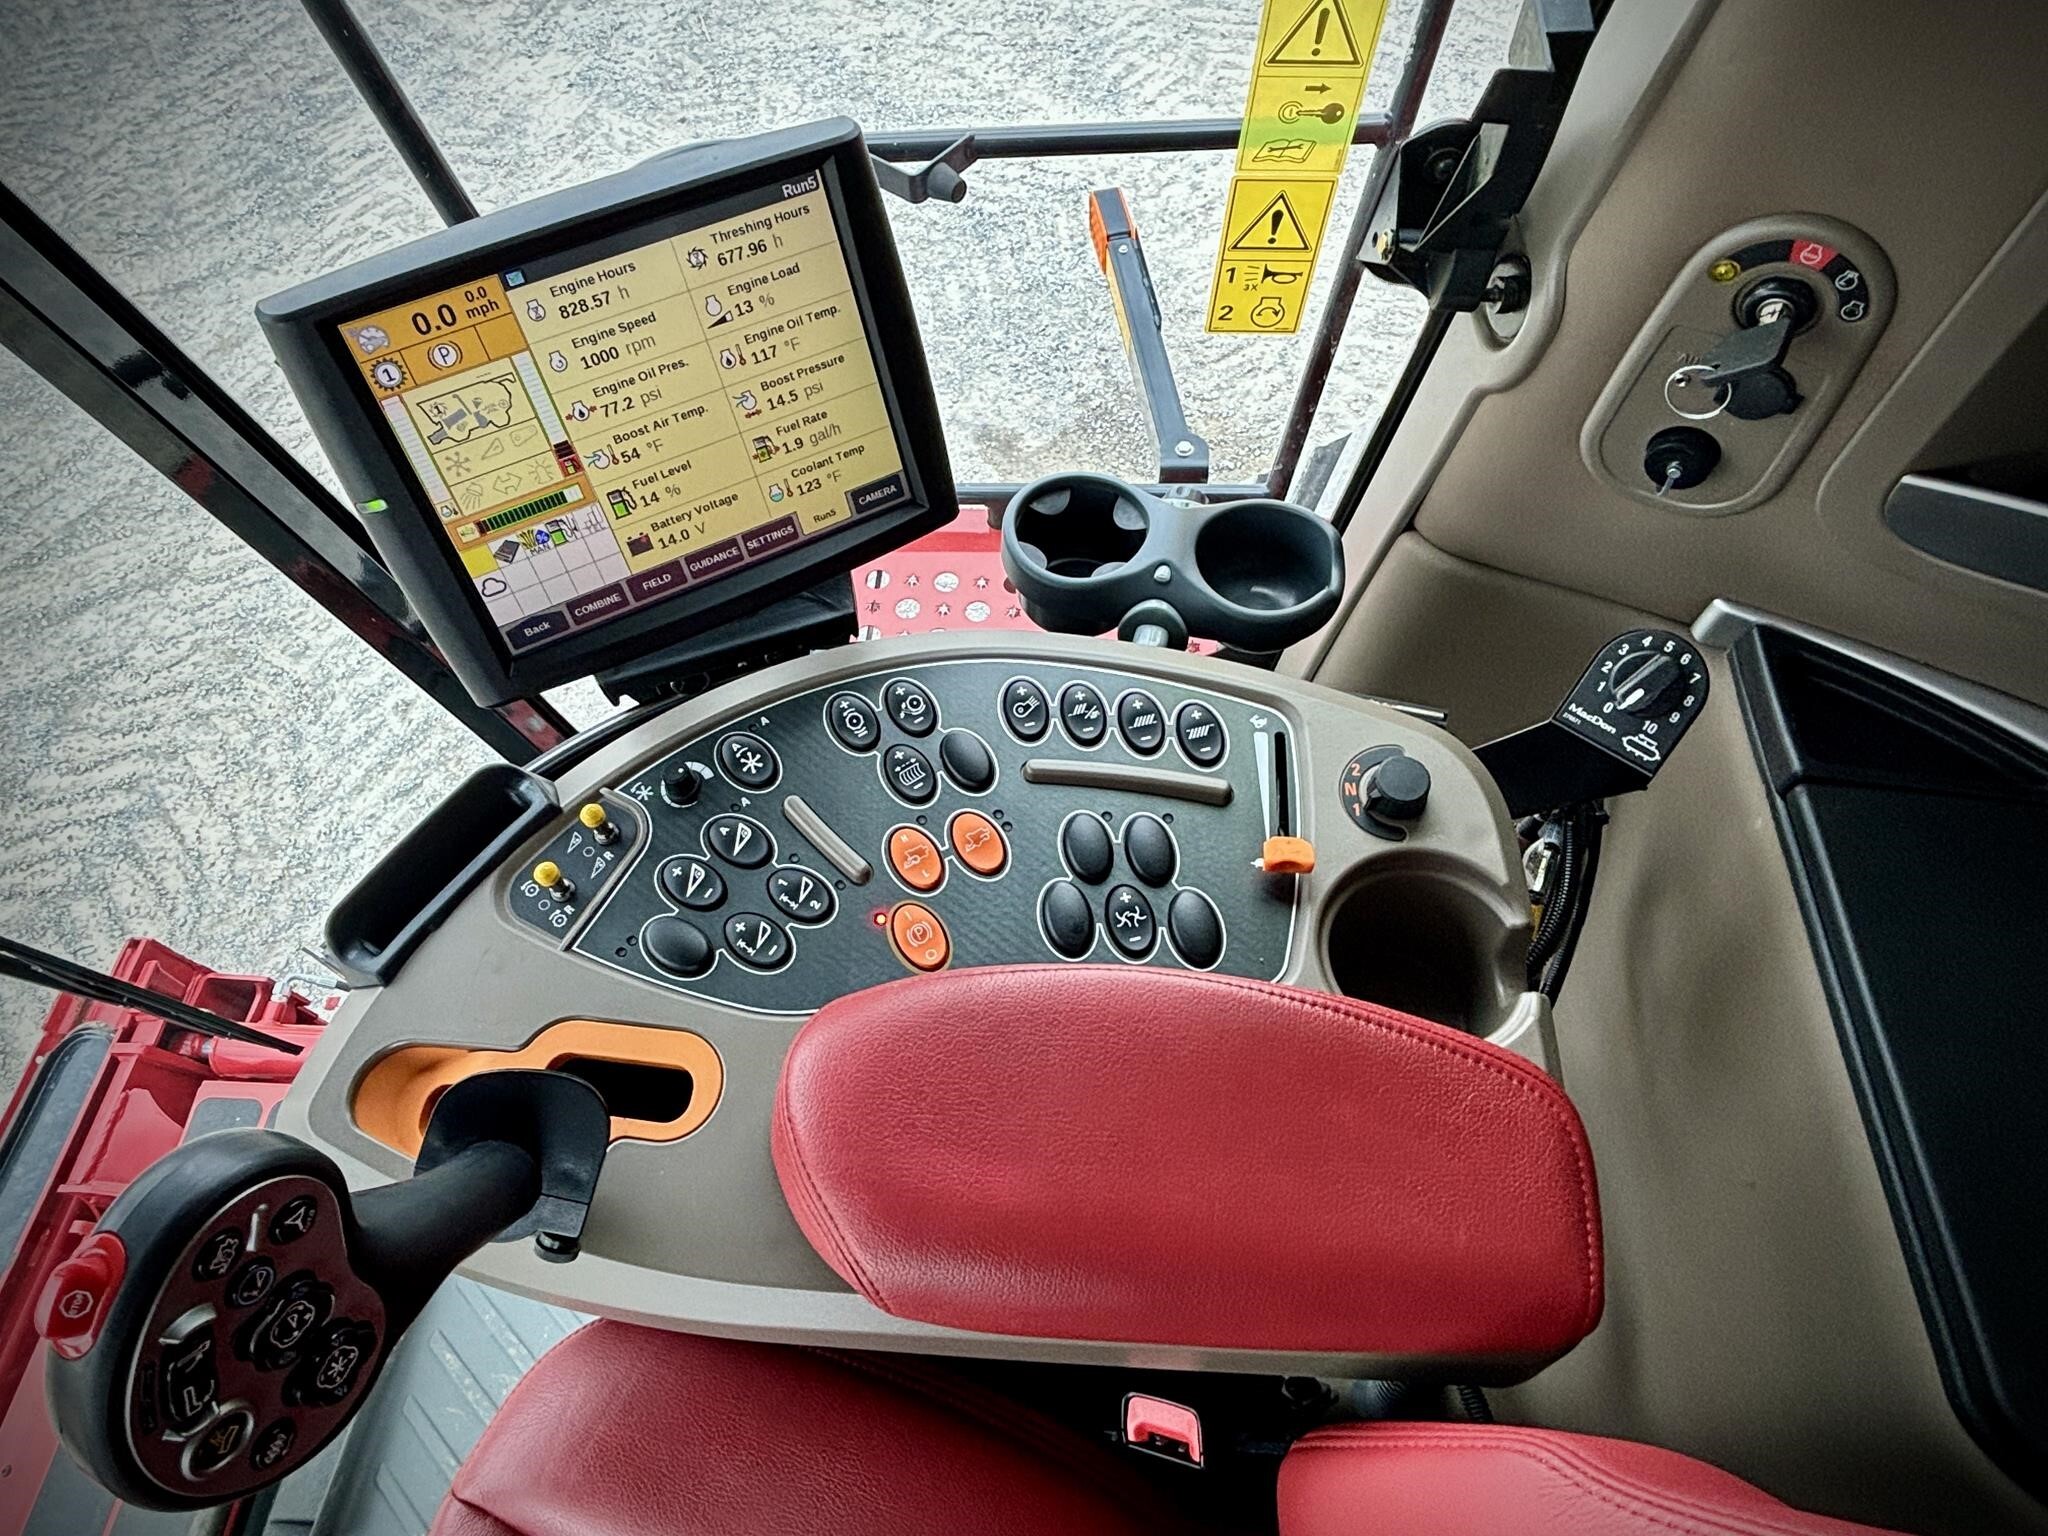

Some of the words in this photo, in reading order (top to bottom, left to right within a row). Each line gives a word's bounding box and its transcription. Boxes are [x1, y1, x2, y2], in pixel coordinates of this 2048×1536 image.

[782, 176, 817, 198] Run5
[710, 216, 773, 245] Threshing
[774, 204, 810, 224] Hours
[717, 239, 767, 266] 677.96
[773, 233, 783, 248] h
[550, 275, 596, 298] Engine
[597, 261, 637, 283] Hours
[727, 273, 769, 296] Engine
[770, 262, 801, 281] Load
[1225, 267, 1236, 284] 1
[465, 286, 487, 303] 0.0
[558, 290, 611, 320] 828.57
[617, 285, 630, 300] h
[735, 300, 754, 317] 13
[758, 293, 775, 307] %
[411, 303, 457, 336] 0.0
[466, 299, 500, 320] mph
[1218, 305, 1234, 321] 2
[571, 326, 617, 349] Engine
[618, 312, 657, 335] Speed
[744, 323, 785, 345] Engine
[787, 314, 804, 330] Oil
[805, 304, 841, 324] Temp.
[580, 346, 620, 370] 1000
[625, 335, 656, 356] rpm
[751, 344, 777, 365] 117
[784, 337, 800, 352] °F
[592, 376, 636, 398] Engine
[638, 369, 656, 384] Oil
[658, 359, 689, 377] Pres.
[760, 371, 795, 391] Boost
[797, 353, 845, 379] Pressure
[600, 397, 635, 418] 77.2
[639, 387, 663, 408] psi
[766, 389, 799, 411] 14.5
[803, 381, 824, 400] psi
[613, 423, 650, 445] Boost
[653, 416, 670, 432] Air
[671, 404, 709, 424] Temp.
[775, 419, 801, 436] Fuel
[802, 410, 828, 426] Rate
[621, 447, 641, 464] 54
[646, 439, 664, 453] °F
[782, 437, 804, 455] 1.9
[809, 423, 842, 446] gal/h
[791, 456, 834, 479] Coolant
[835, 443, 865, 463] Temp
[632, 472, 660, 490] Fuel
[660, 460, 692, 479] Level
[796, 477, 822, 496] 123
[826, 469, 842, 484] °F
[640, 491, 660, 508] 14
[665, 484, 682, 499] %
[858, 484, 898, 506] CAMERA
[650, 510, 693, 533] Battery
[694, 492, 739, 517] Voltage
[813, 509, 837, 524] Run5
[658, 528, 690, 550] 14.0
[695, 522, 706, 536] V
[746, 524, 795, 550] SETTINGS
[689, 546, 740, 573] GUIDANCE
[642, 573, 672, 592] FIELD
[574, 593, 622, 618] COMBINE
[524, 620, 550, 638] Back
[1618, 643, 1630, 656] 3
[1641, 636, 1653, 648] 4
[1664, 640, 1676, 653] 5
[1601, 661, 1613, 674] 2
[1680, 653, 1692, 665] 6
[1597, 681, 1606, 692] 1
[1689, 673, 1701, 684] 7
[1603, 702, 1614, 714] 0
[1683, 695, 1695, 707] 8
[1568, 702, 1617, 735] MacDon
[1642, 720, 1659, 735] 10
[1669, 712, 1680, 724] 9
[1350, 763, 1361, 776] 2
[1344, 782, 1357, 796] N
[1352, 803, 1361, 817] 1
